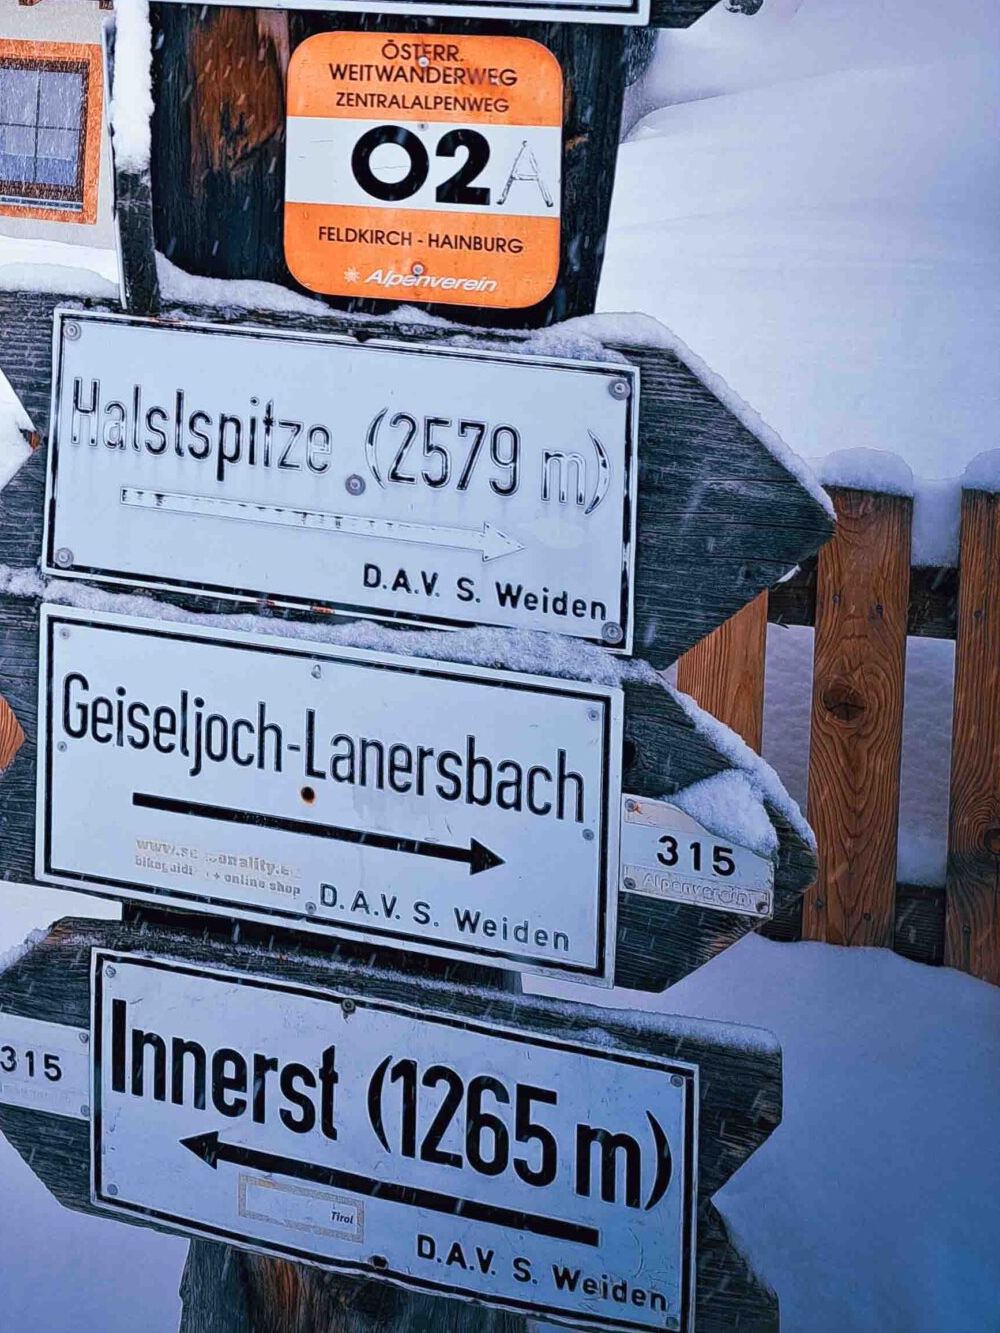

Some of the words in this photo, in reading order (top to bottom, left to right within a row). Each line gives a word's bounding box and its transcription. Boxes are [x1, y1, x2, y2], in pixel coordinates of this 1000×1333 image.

[328, 63, 518, 87] WEITWANDERWEG
[335, 91, 509, 113] ZENTRALALPENWEG
[318, 226, 412, 246] FELDKIRCH
[428, 235, 524, 254] HAINBURG
[364, 268, 498, 292] Alpenverein
[72, 376, 333, 481] Halslspitze
[365, 406, 520, 496] (2579
[540, 428, 611, 516] m)
[363, 563, 440, 597] D.A.V.
[456, 578, 482, 602] S.
[496, 582, 607, 621] Weiden
[62, 672, 585, 824] Geiseljoch-Lanersbach
[657, 835, 735, 876] 315
[269, 880, 301, 899] shop
[319, 883, 401, 920] D.A.V.
[413, 901, 440, 926] S.
[454, 907, 570, 952] Weiden
[0, 1045, 62, 1081] 315
[110, 999, 340, 1143] Innerst
[367, 1053, 560, 1189] (1265
[574, 1108, 676, 1212] m)
[331, 1211, 353, 1224] Tirol
[416, 1234, 496, 1278] D.A.V.
[513, 1261, 540, 1284] S.
[552, 1269, 668, 1312] Weiden
